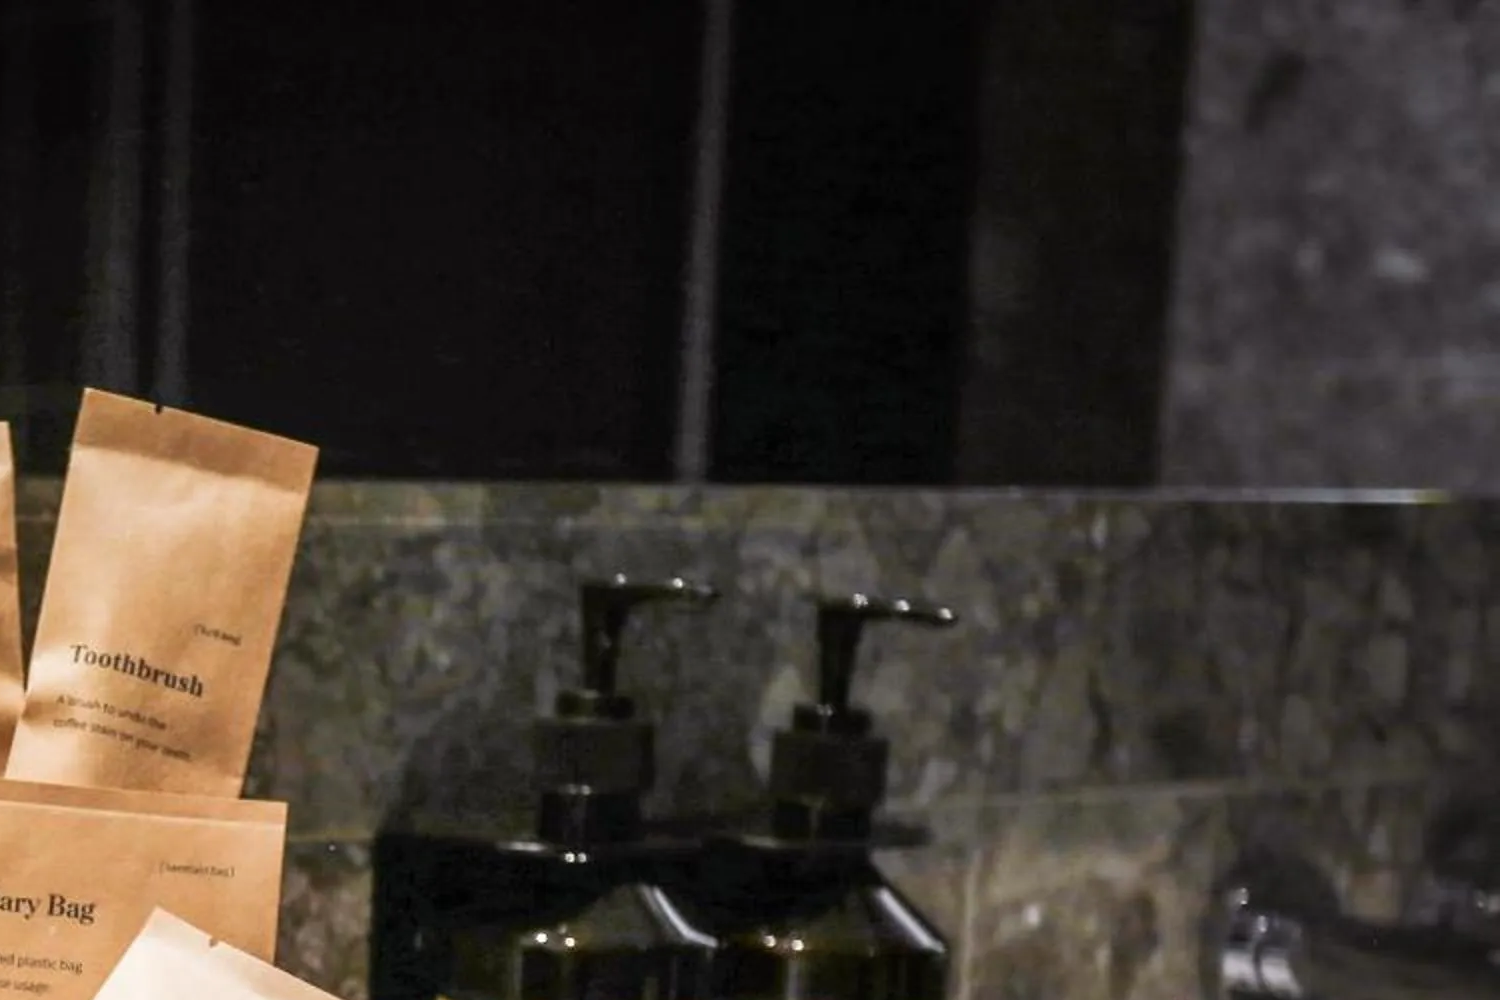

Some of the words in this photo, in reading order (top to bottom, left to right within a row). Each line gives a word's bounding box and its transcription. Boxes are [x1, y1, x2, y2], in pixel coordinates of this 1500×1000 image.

[71, 643, 204, 698] Toothbrush
[46, 893, 96, 925] Bag
[60, 957, 84, 976] bag
